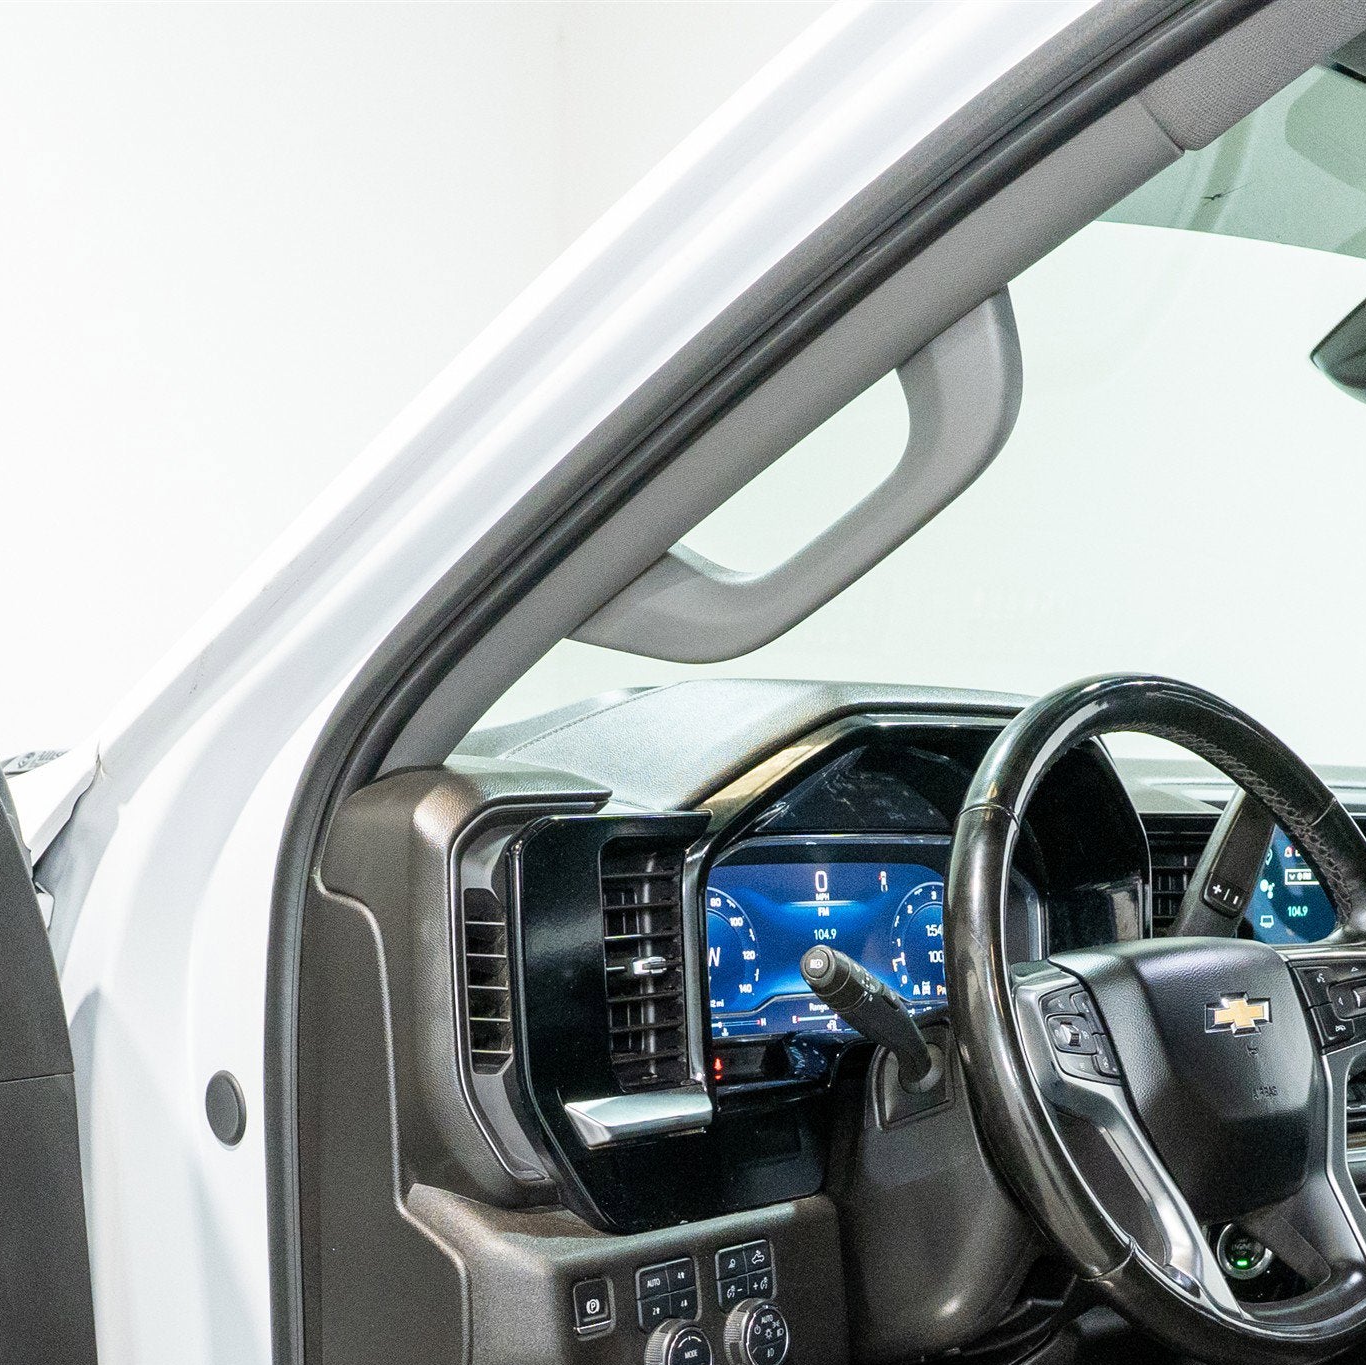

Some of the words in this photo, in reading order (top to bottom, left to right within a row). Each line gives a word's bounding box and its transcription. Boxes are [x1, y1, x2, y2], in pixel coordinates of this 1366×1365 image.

[815, 870, 828, 892] 0
[815, 893, 830, 901] MPH
[818, 906, 830, 917] FM
[1287, 905, 1309, 918] 104.9
[729, 916, 744, 927] 100
[814, 928, 837, 940] 104.9
[742, 950, 756, 960] 120
[739, 983, 753, 994] 140
[647, 1277, 661, 1288] AUTO
[761, 1314, 773, 1324] AUTO
[684, 1349, 698, 1359] MODE
